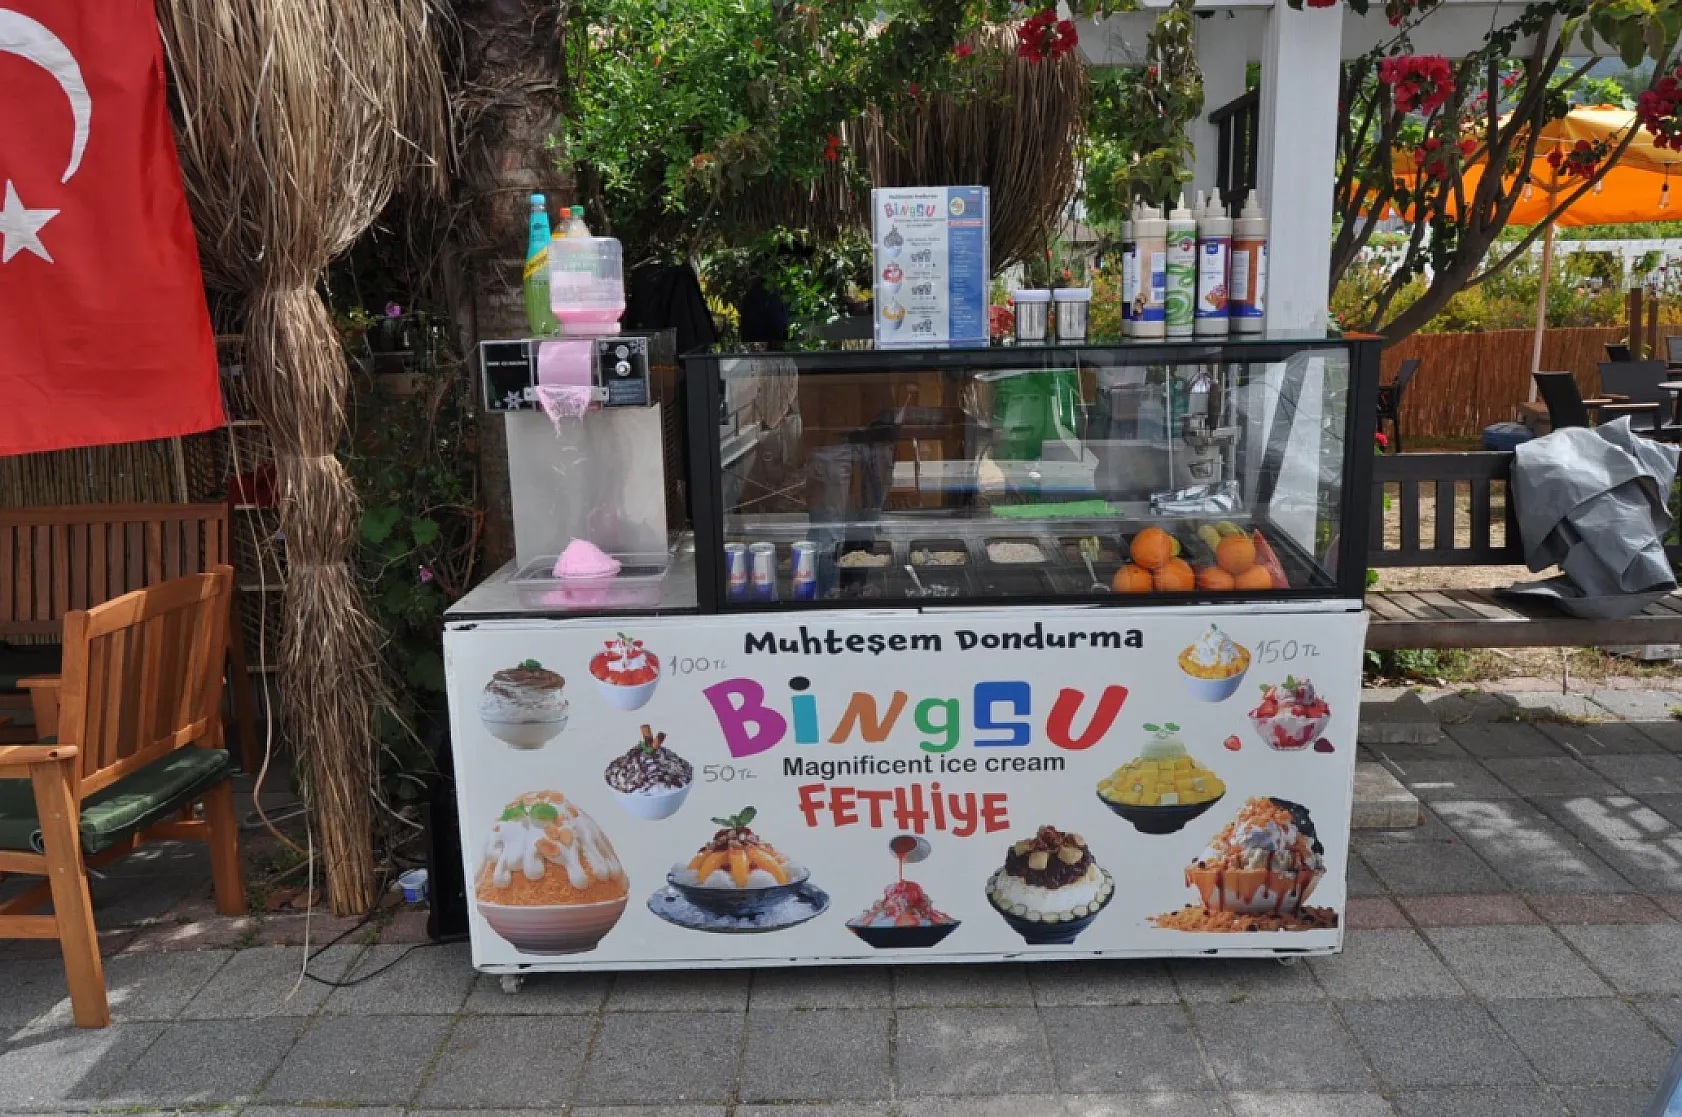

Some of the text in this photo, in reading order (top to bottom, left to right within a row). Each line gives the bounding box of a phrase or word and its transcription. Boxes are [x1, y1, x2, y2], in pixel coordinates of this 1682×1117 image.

[743, 621, 1144, 657] Muhteşem Dondurma
[1256, 639, 1321, 664] 150 TL
[668, 655, 710, 676] 100
[703, 764, 735, 782] 50
[783, 753, 1066, 781] Magnificent ice cream
